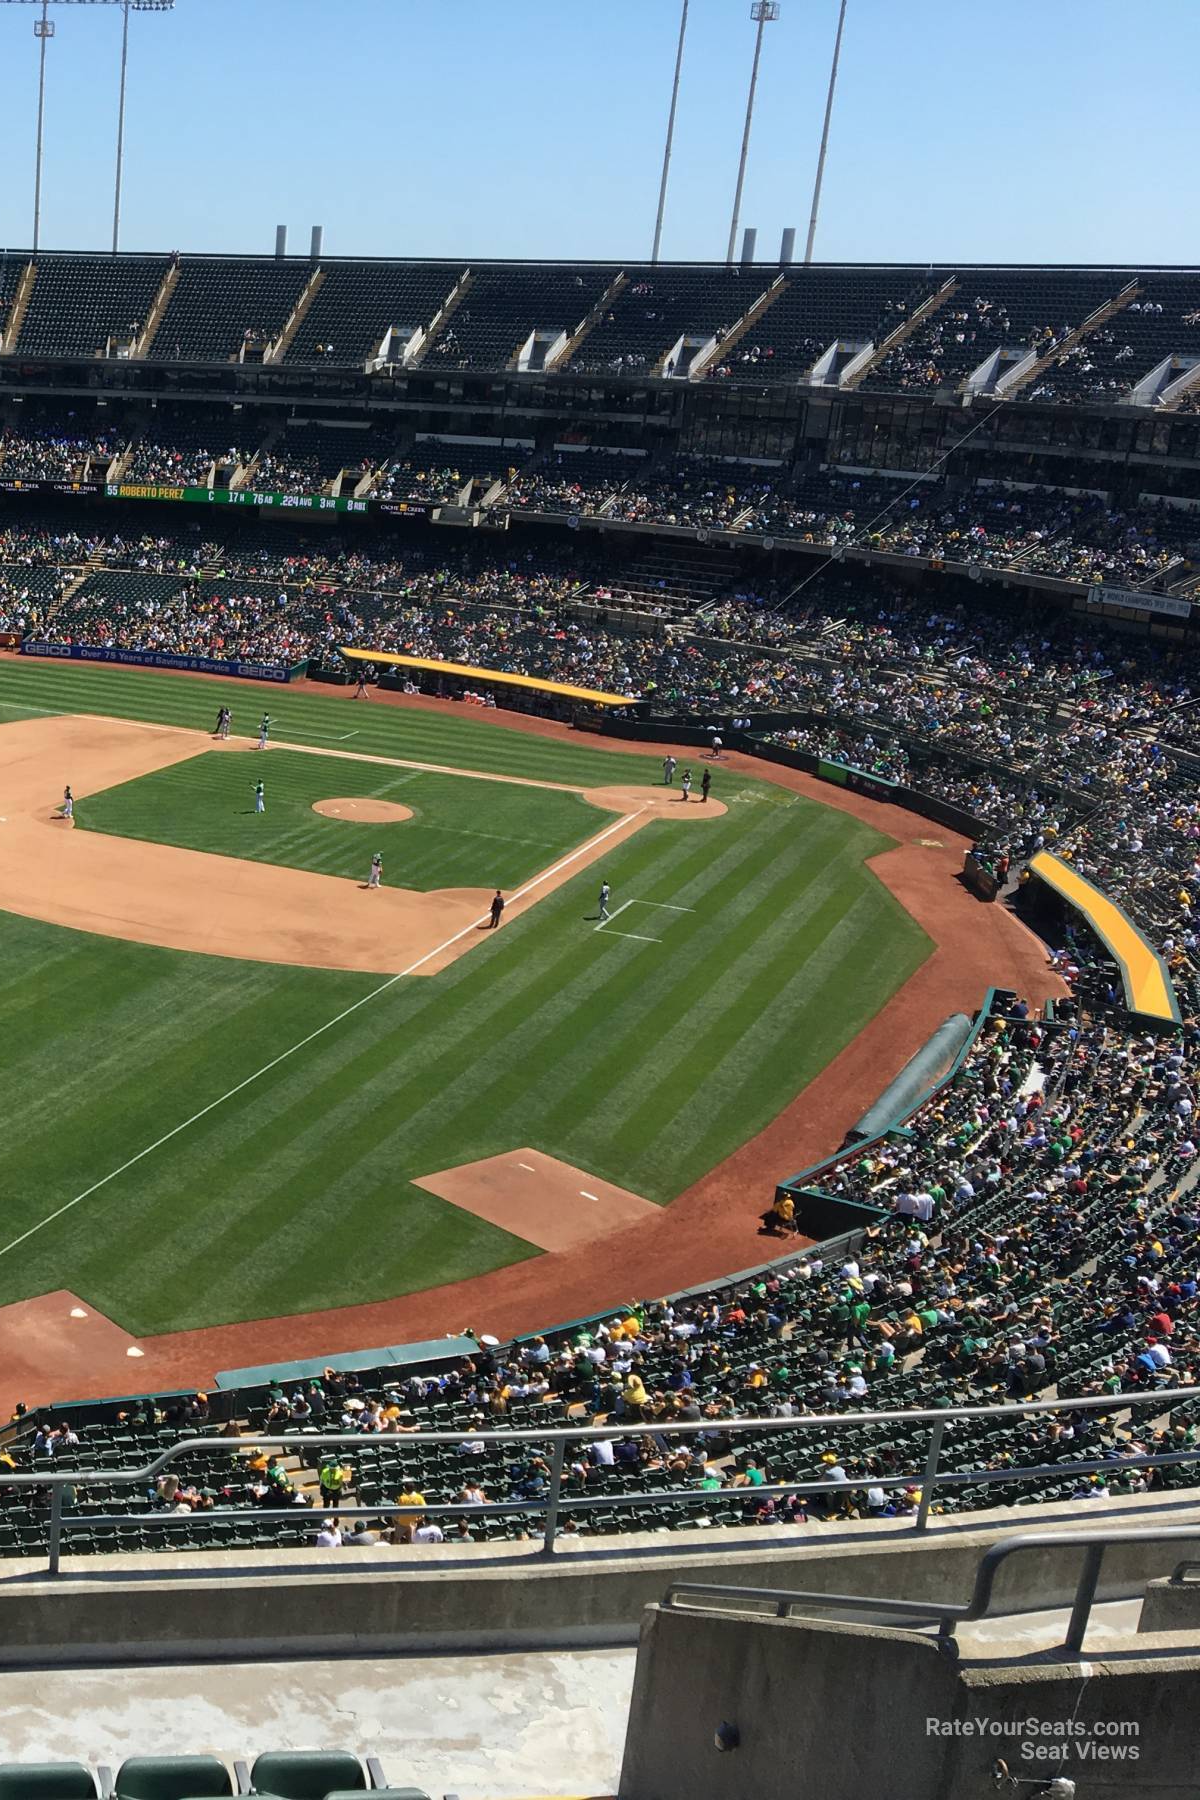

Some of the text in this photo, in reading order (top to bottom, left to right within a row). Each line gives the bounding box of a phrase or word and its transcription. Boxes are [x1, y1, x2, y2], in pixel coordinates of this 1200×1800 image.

[107, 485, 118, 496] 55
[120, 486, 157, 498] ROBERTO
[158, 488, 184, 499] PEREZ
[208, 490, 214, 500] C
[228, 492, 238, 502] 17
[253, 494, 264, 504] 76
[264, 496, 274, 504] AB
[280, 496, 299, 507] .224
[300, 498, 312, 507] AVG
[320, 497, 326, 508] 3
[326, 500, 336, 508] HR
[347, 500, 354, 510] 8
[354, 502, 366, 511] RBI
[25, 644, 71, 656] GEICO
[81, 650, 102, 658] Over
[119, 653, 142, 662] Years
[144, 654, 154, 662] of
[156, 657, 188, 668] Savings
[200, 661, 230, 673] Service
[238, 665, 286, 680] GEICO
